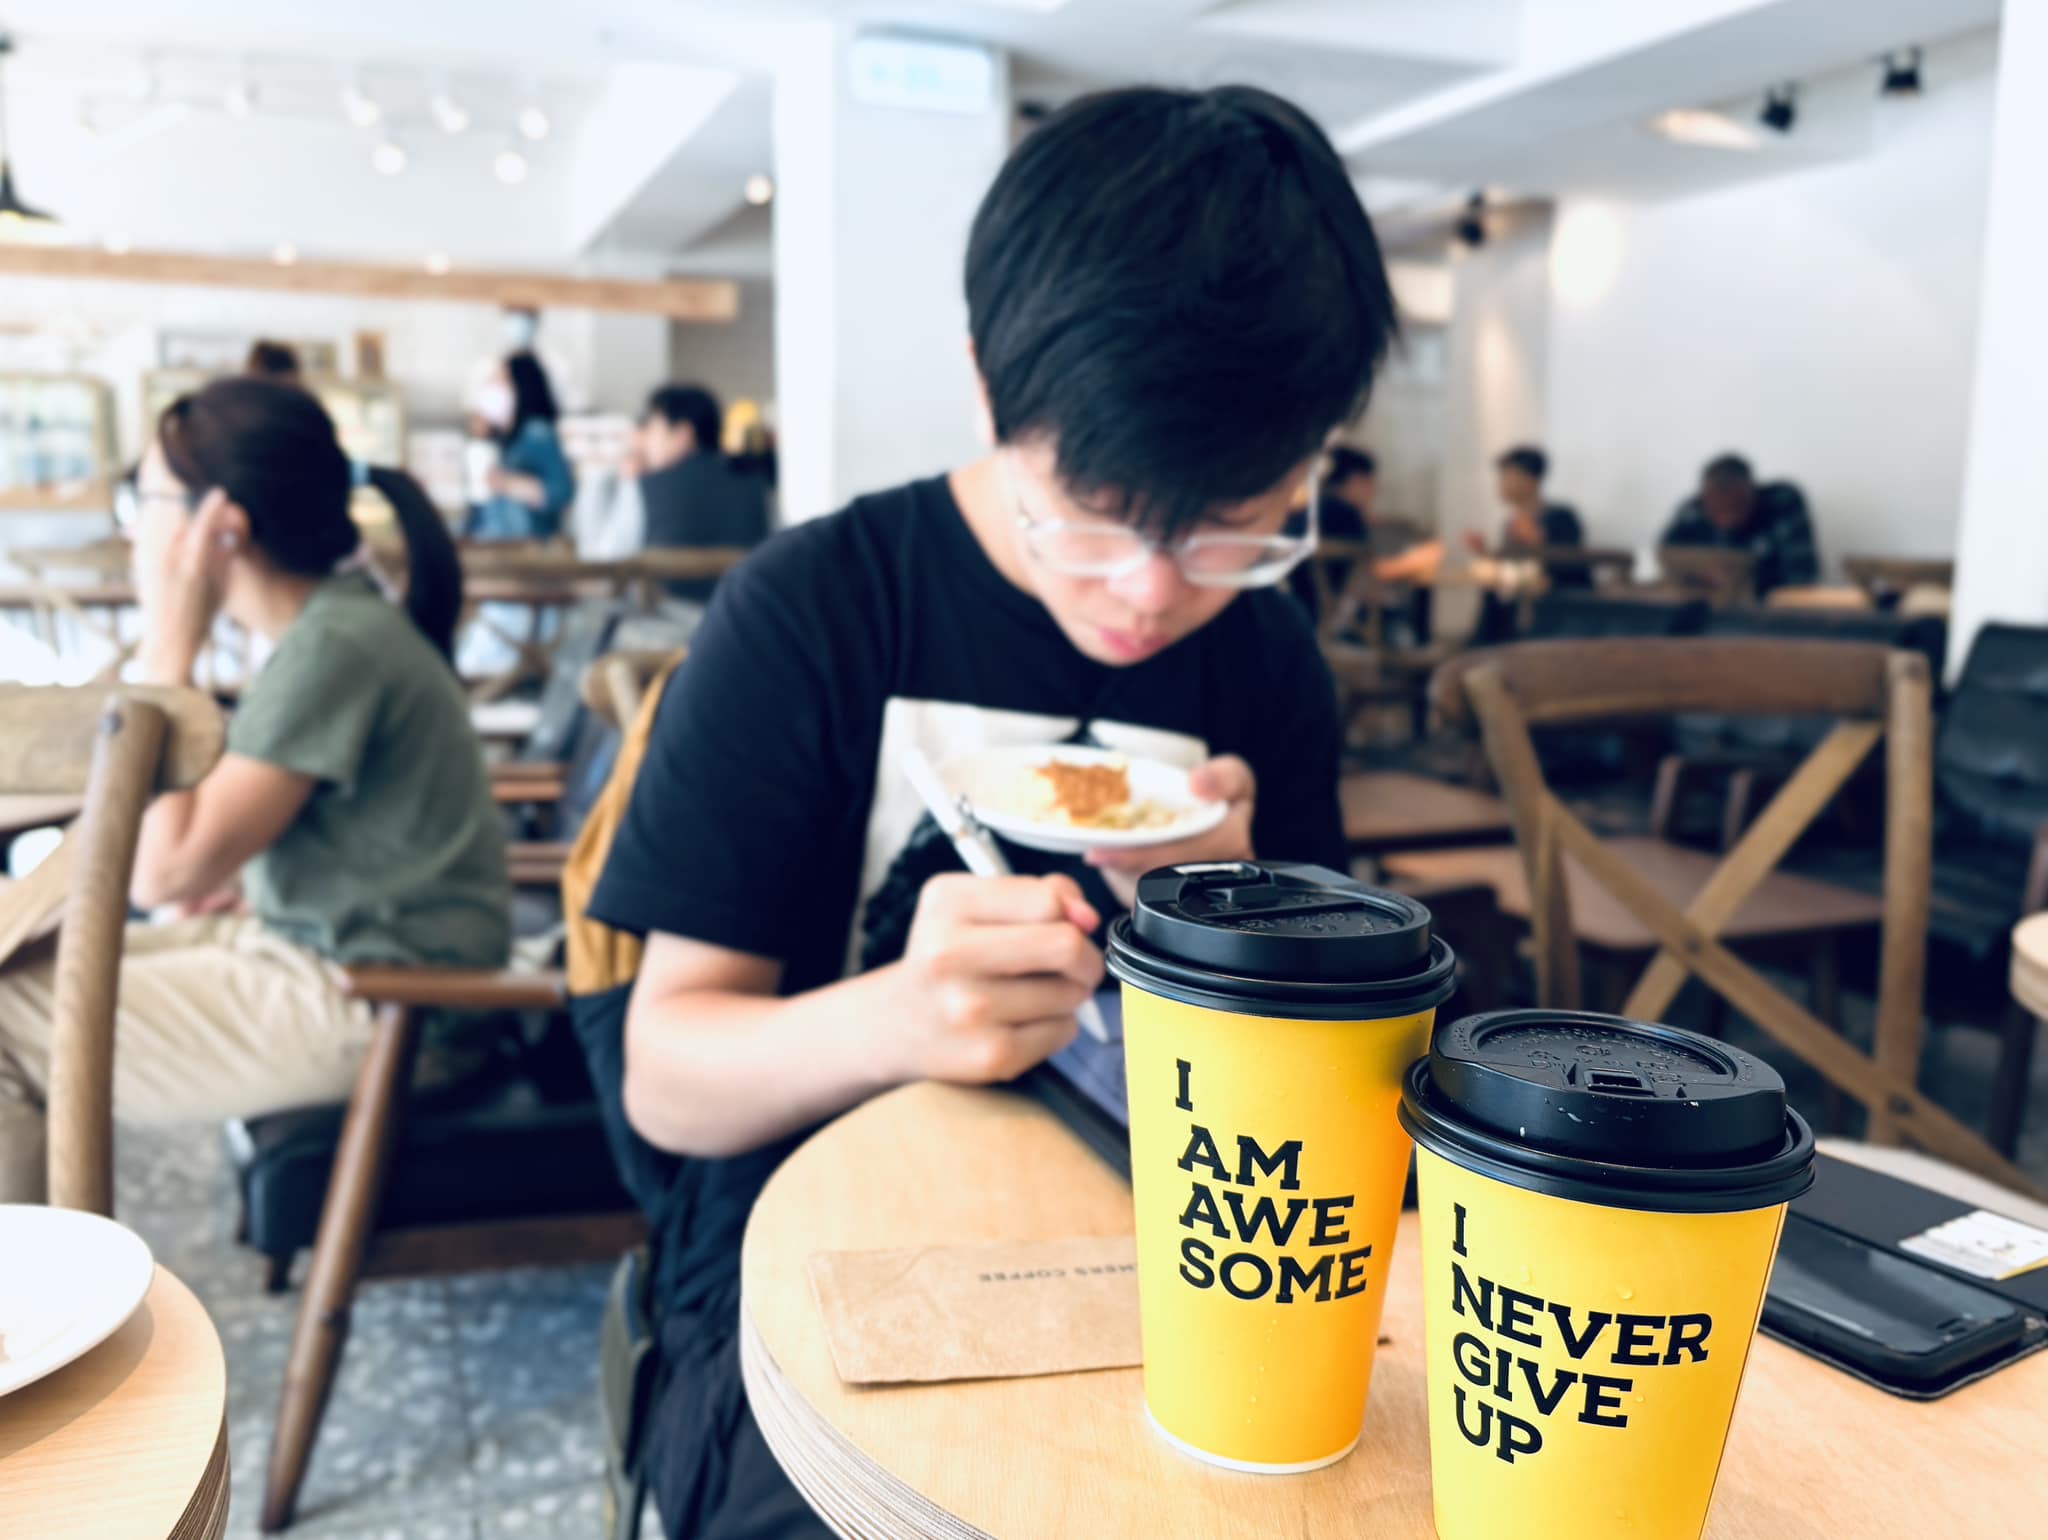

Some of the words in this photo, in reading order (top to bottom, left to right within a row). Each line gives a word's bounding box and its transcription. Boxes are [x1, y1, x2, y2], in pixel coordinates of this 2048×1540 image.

[1175, 1057, 1194, 1112] I
[1177, 1124, 1303, 1191] AM
[1178, 1182, 1356, 1248] AWE
[1452, 1202, 1468, 1258] I
[978, 1268, 1067, 1283] COFFEE
[1073, 1263, 1137, 1277] MERS
[1178, 1237, 1373, 1304] SOME
[1452, 1261, 1713, 1367] NEVER
[1453, 1331, 1635, 1429] GIVE
[1453, 1384, 1544, 1465] UP
